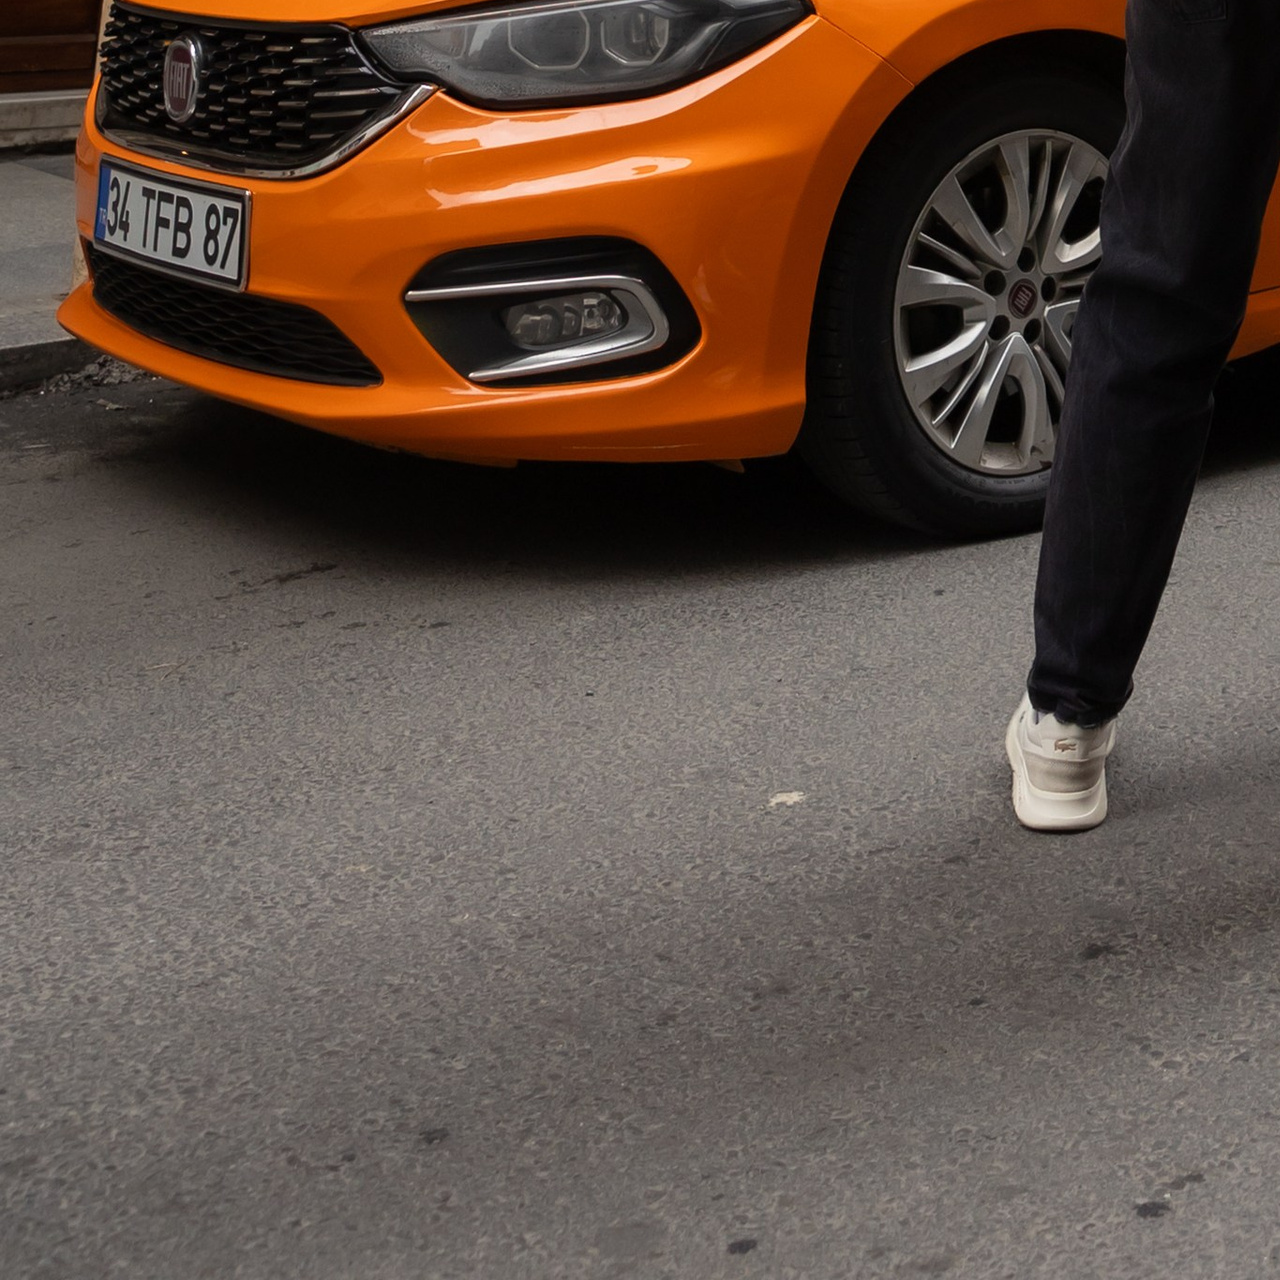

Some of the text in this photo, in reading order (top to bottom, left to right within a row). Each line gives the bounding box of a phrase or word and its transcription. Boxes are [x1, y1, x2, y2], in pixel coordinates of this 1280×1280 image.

[169, 60, 191, 100] FIAT
[107, 175, 240, 270] 34 TFB 87
[1013, 286, 1033, 312] FIAT
